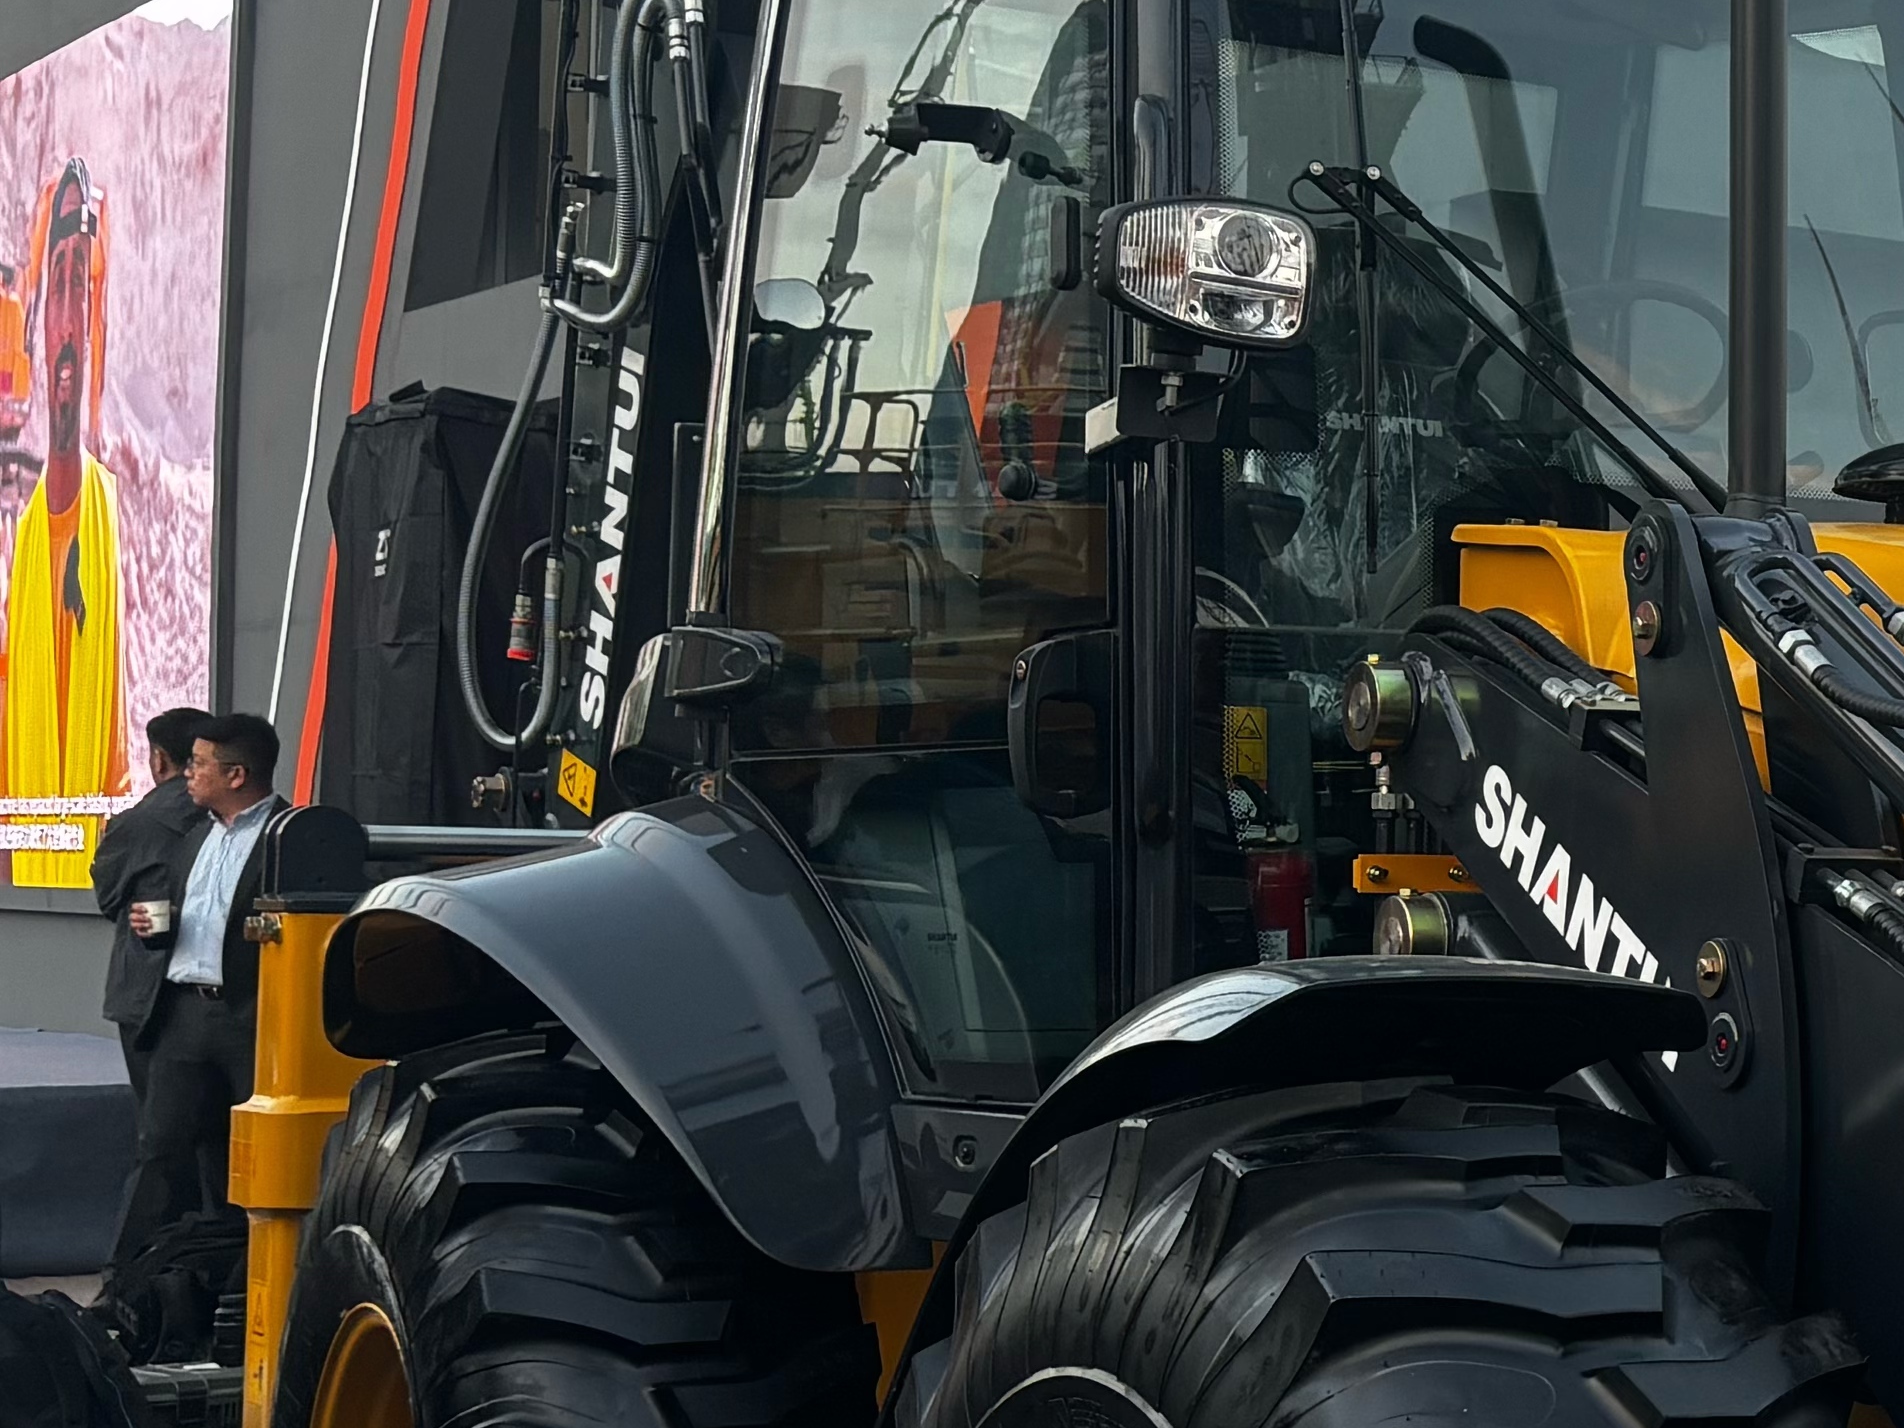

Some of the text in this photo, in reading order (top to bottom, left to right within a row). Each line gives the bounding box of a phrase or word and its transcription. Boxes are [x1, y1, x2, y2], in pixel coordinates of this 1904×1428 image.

[1326, 410, 1443, 438] SHNTUI
[579, 346, 645, 729] SHANTUI
[1474, 764, 1671, 988] SHANT
